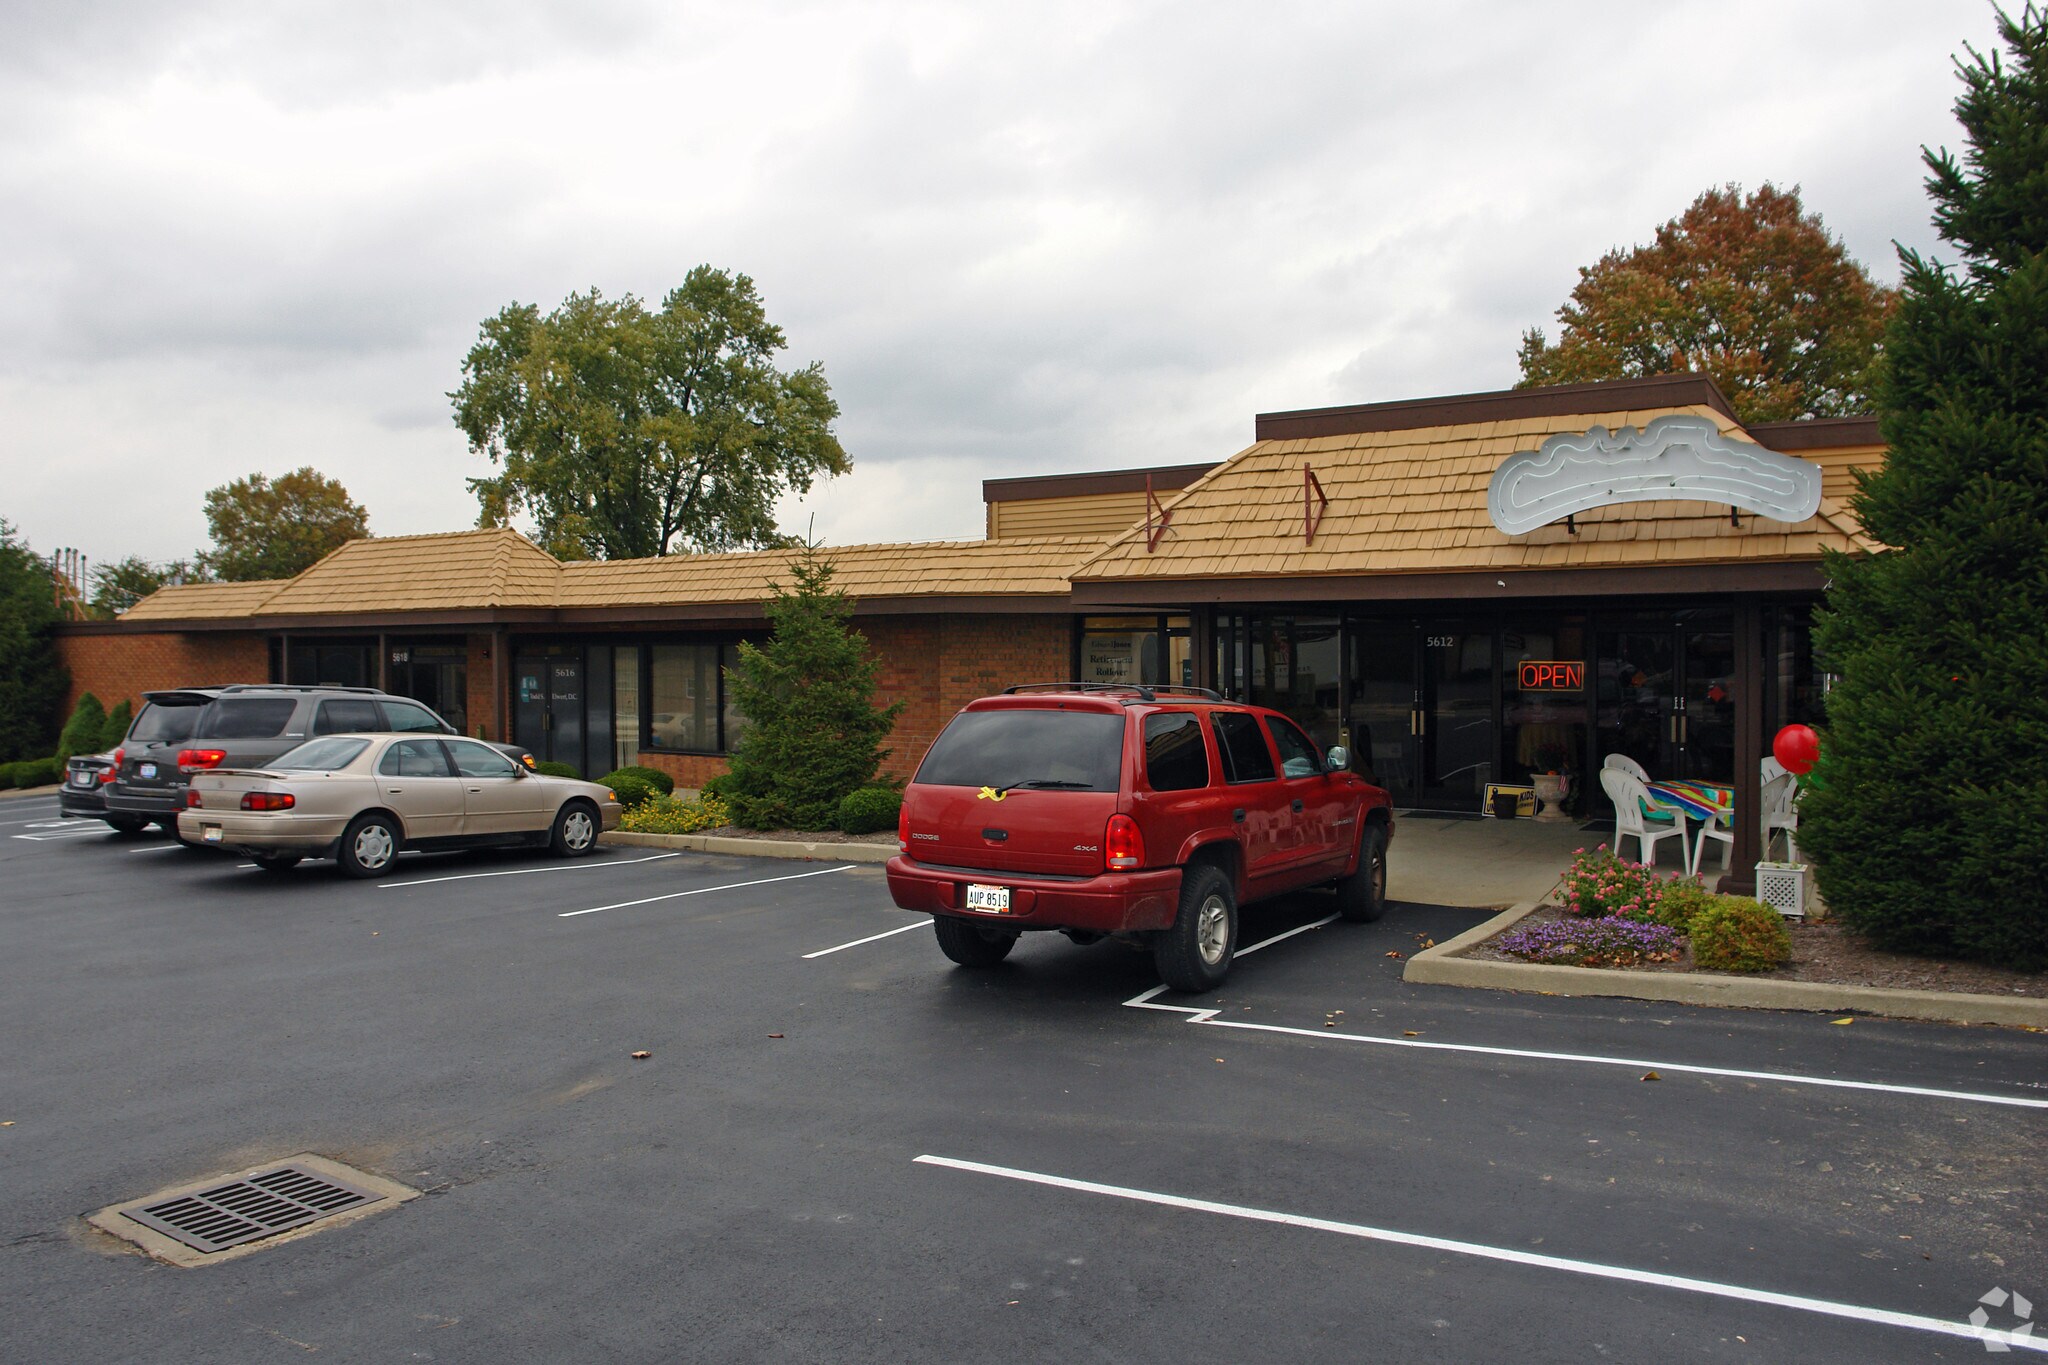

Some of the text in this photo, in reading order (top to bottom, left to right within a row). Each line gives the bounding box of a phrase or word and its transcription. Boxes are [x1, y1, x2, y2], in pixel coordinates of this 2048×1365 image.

[1427, 636, 1454, 647] 5612
[392, 652, 408, 662] 5618
[555, 668, 575, 677] 5616
[1096, 667, 1128, 676] Rollover
[1522, 664, 1581, 687] OPEN
[1519, 791, 1535, 802] KIDS
[912, 833, 940, 841] DODGE
[969, 891, 1008, 908] AUP 8519
